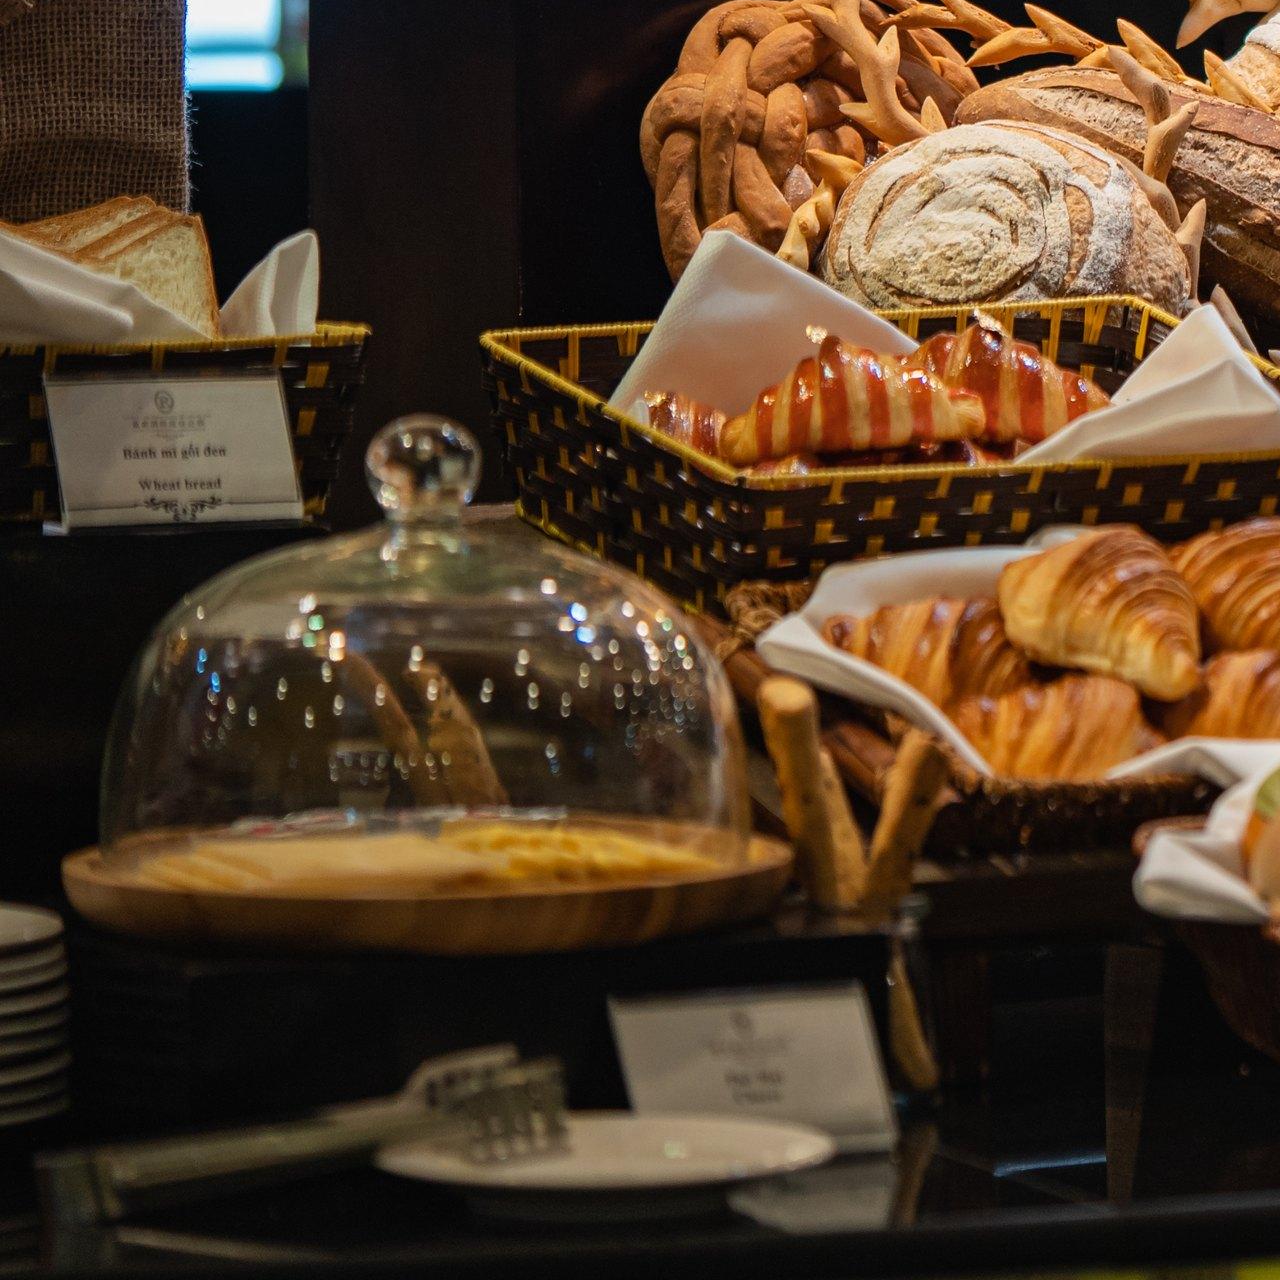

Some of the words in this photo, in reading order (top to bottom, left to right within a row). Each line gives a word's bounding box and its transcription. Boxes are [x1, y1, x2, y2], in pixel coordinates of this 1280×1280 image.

[122, 447, 157, 460] Bánh
[138, 478, 181, 491] Wheat
[184, 478, 223, 490] bread
